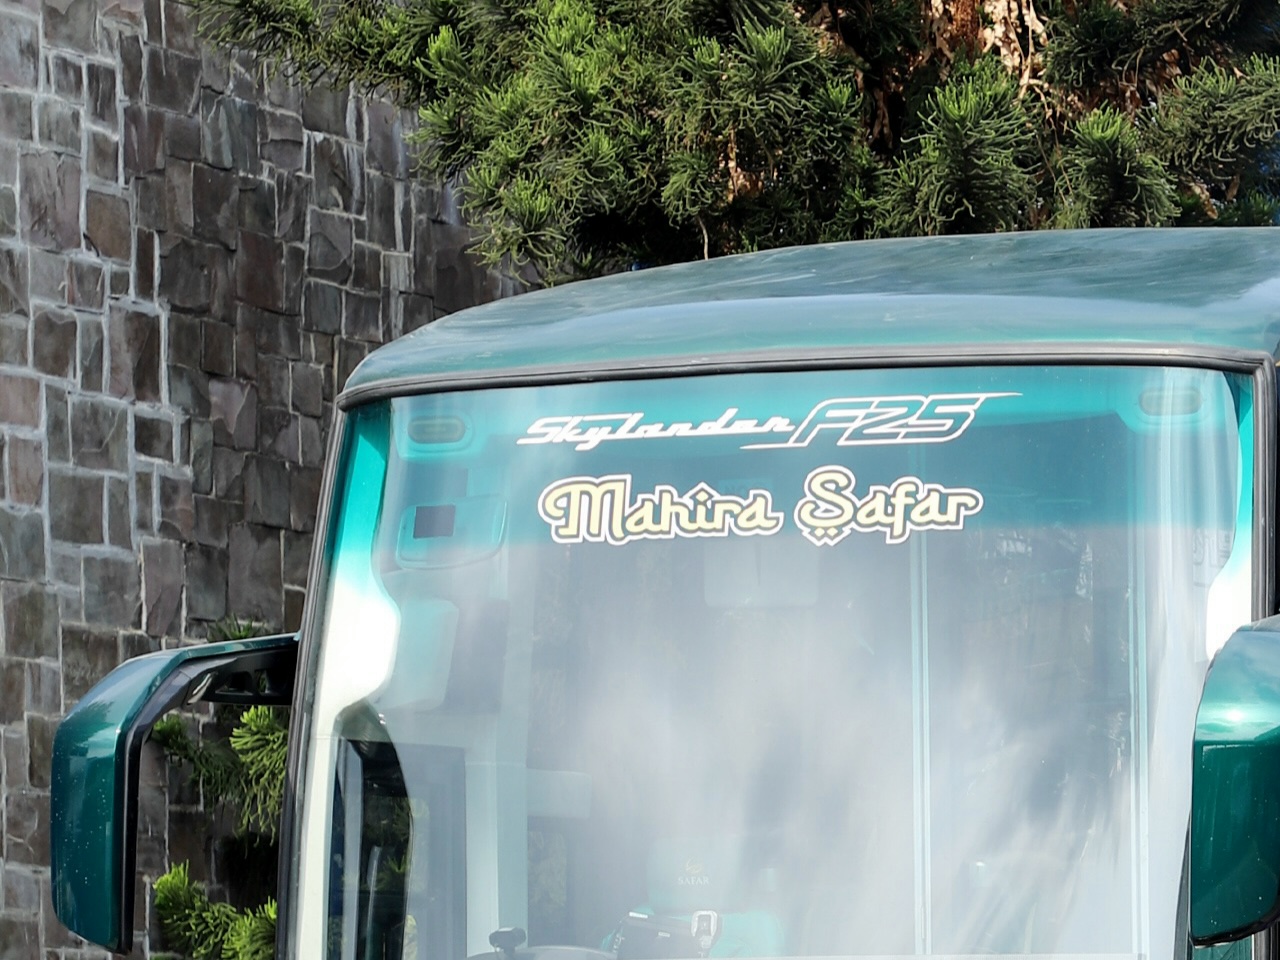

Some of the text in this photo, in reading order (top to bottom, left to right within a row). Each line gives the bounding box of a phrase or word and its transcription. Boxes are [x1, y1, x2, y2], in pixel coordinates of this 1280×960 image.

[516, 392, 1023, 451] Skylander F25
[537, 464, 984, 546] Mahira Safar
